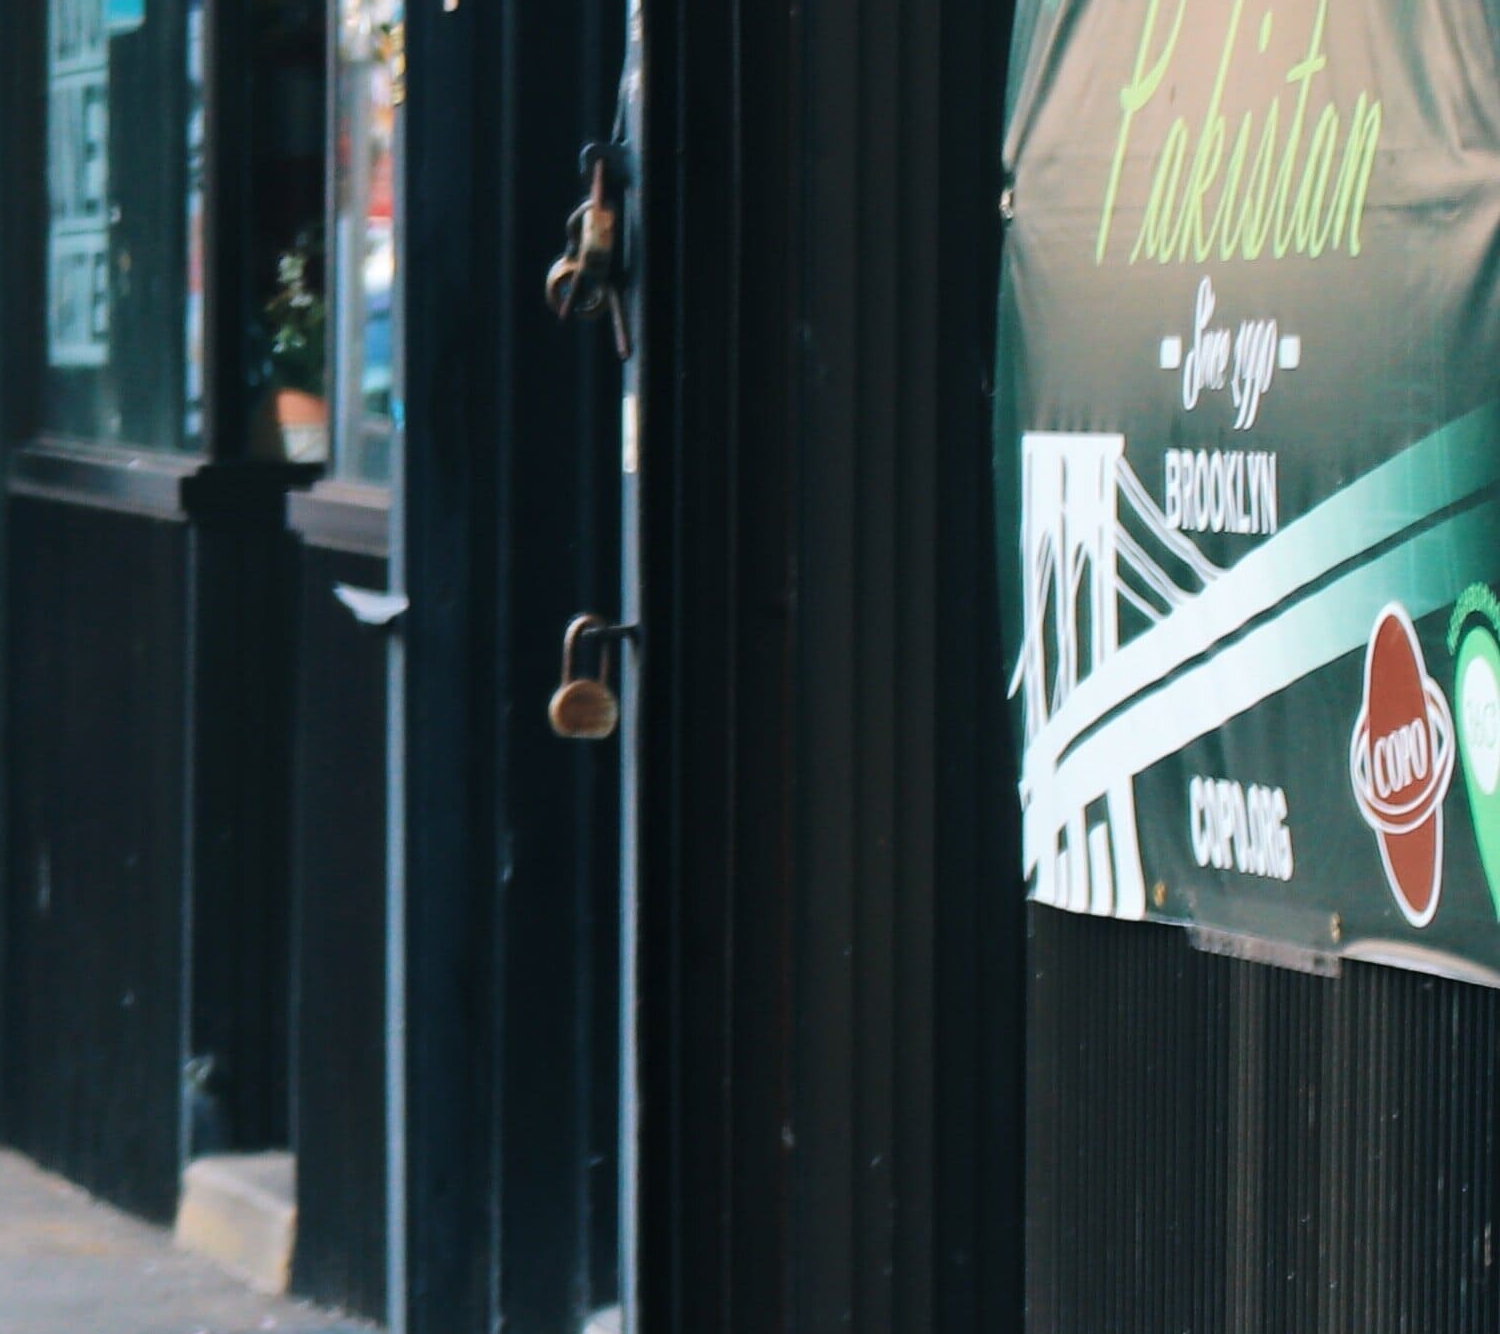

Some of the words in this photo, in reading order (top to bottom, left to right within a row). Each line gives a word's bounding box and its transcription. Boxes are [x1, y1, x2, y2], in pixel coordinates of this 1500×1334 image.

[1165, 448, 1278, 535] BROOKLYN
[1373, 716, 1429, 799] COPO
[1189, 775, 1293, 882] COPO.ORG
